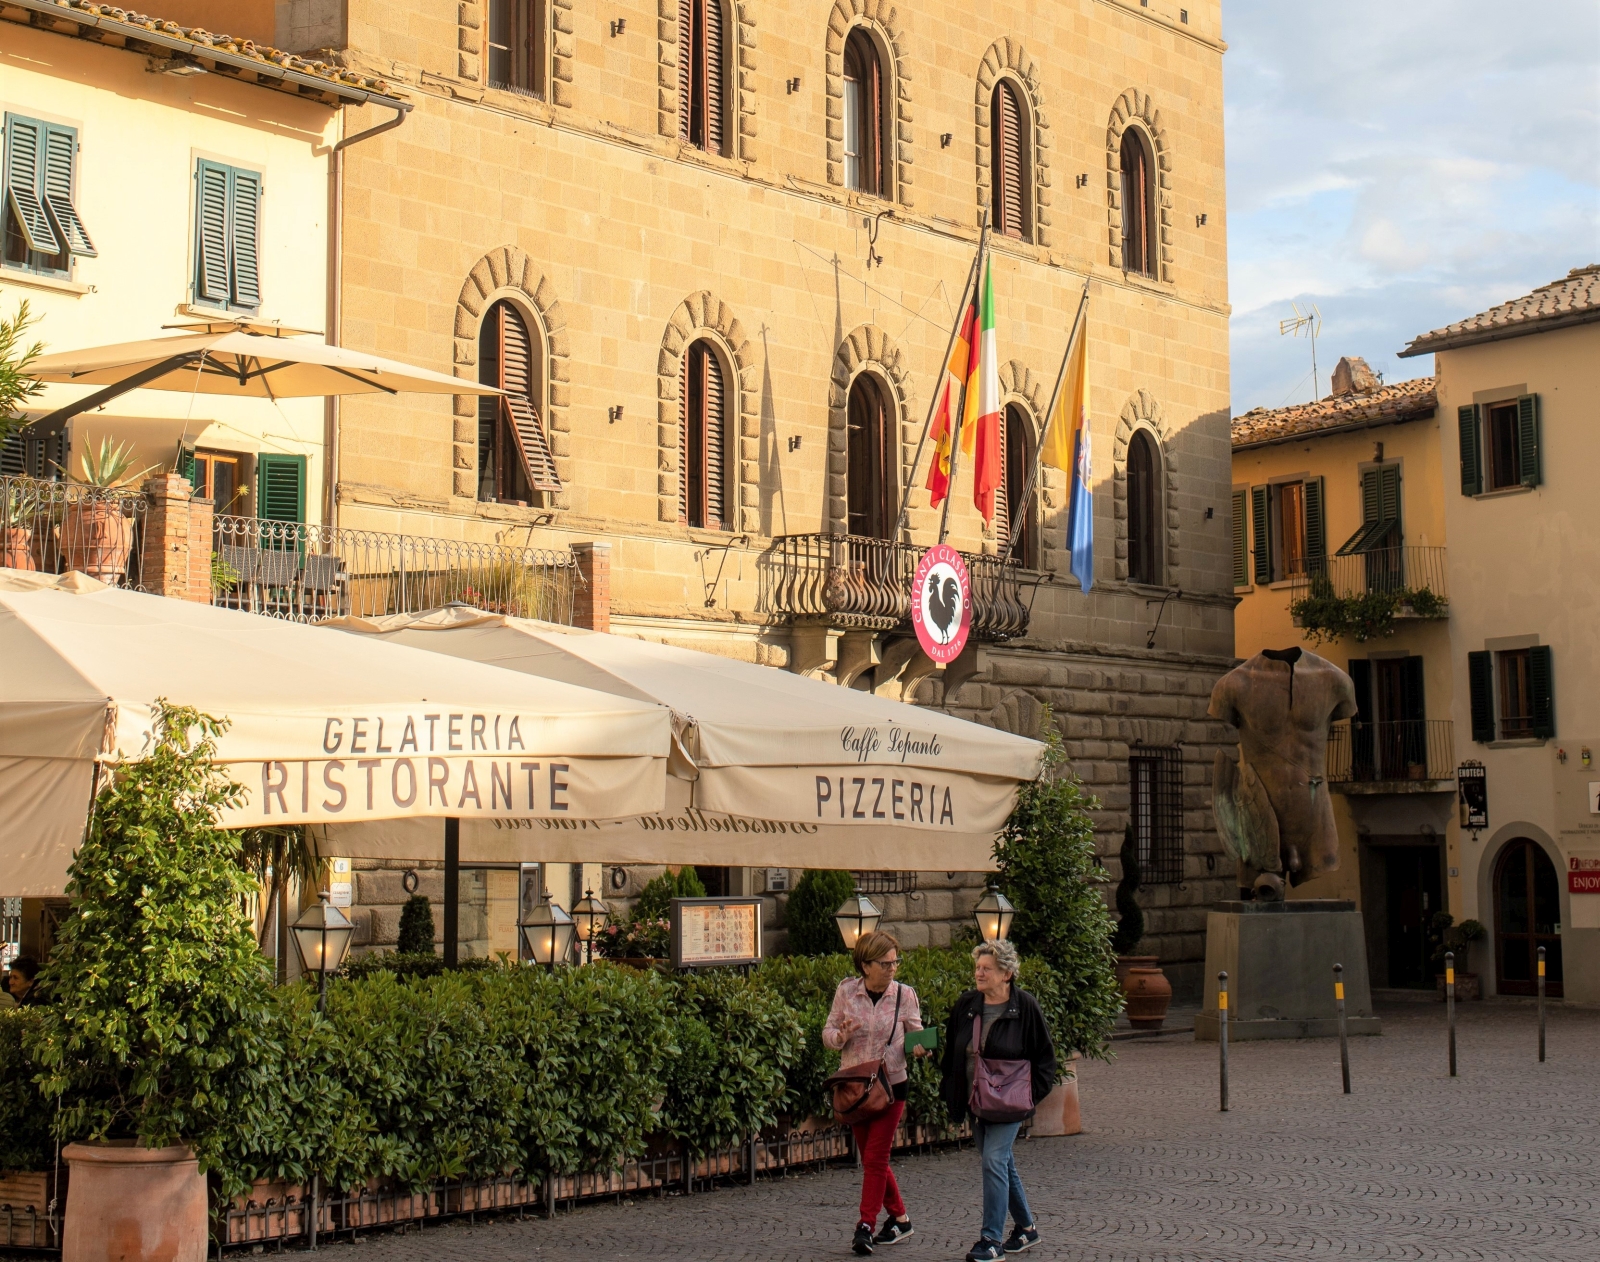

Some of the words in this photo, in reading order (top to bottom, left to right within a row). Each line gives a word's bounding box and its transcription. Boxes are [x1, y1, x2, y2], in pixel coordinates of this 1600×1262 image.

[913, 552, 936, 623] CHIANTI
[938, 548, 970, 610] CLASSICO
[931, 646, 945, 658] DAL
[947, 640, 962, 657] 1716
[322, 713, 526, 755] GELATERIA
[886, 727, 943, 763] Lepanto
[261, 756, 570, 816] RISTORANTE
[1458, 768, 1485, 778] ENOTECA
[815, 775, 954, 826] PIZZERIA
[339, 862, 344, 871] 6
[1573, 876, 1600, 891] ENJOY
